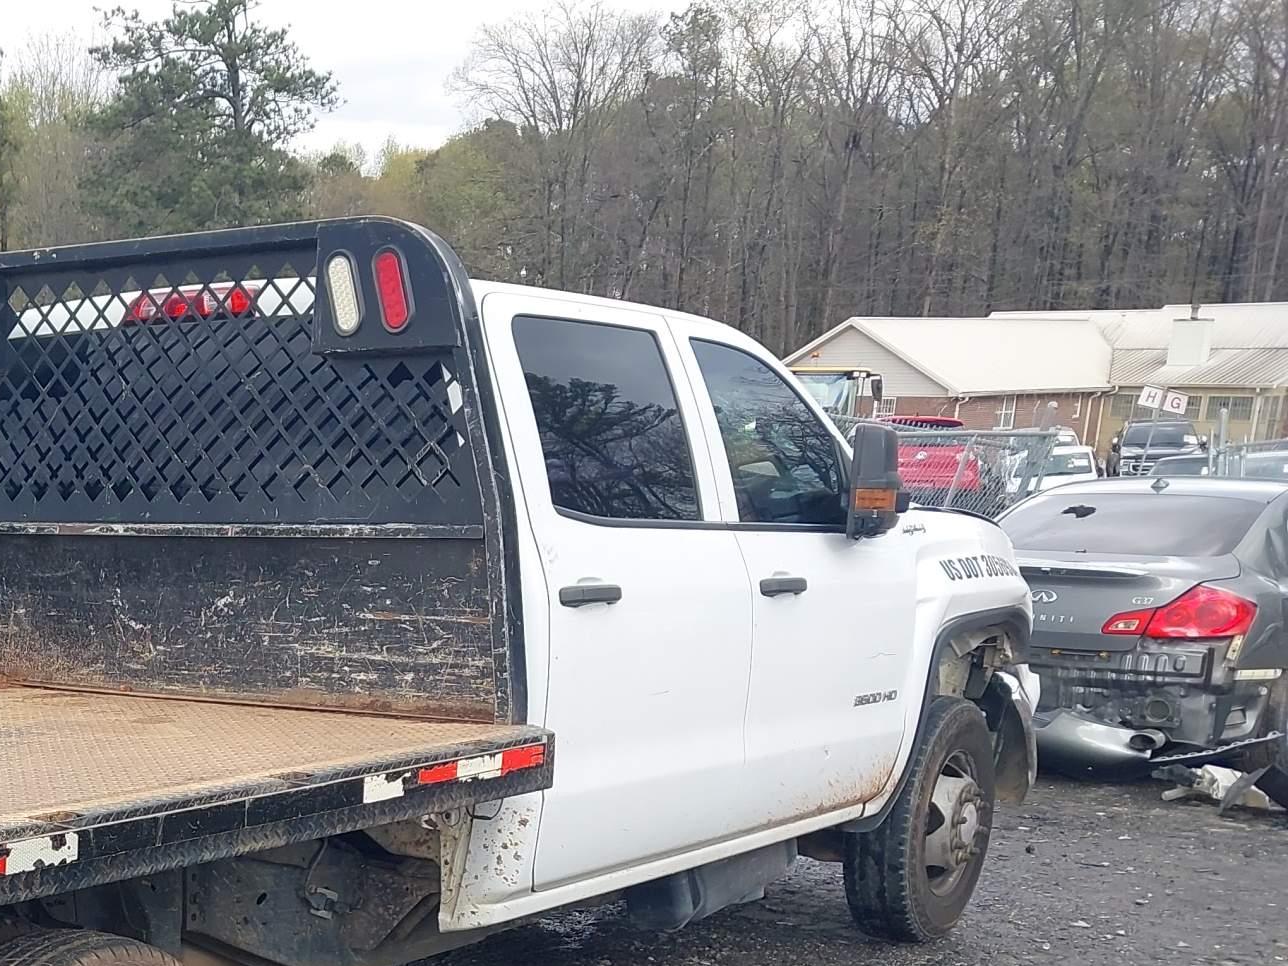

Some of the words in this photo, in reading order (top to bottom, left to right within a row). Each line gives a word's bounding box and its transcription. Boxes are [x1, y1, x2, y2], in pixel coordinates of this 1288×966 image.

[1145, 390, 1158, 404] H
[1170, 396, 1182, 409] G
[938, 559, 964, 581] US
[956, 556, 985, 579] DOT
[1131, 596, 1154, 605] G37
[882, 689, 898, 703] HD
